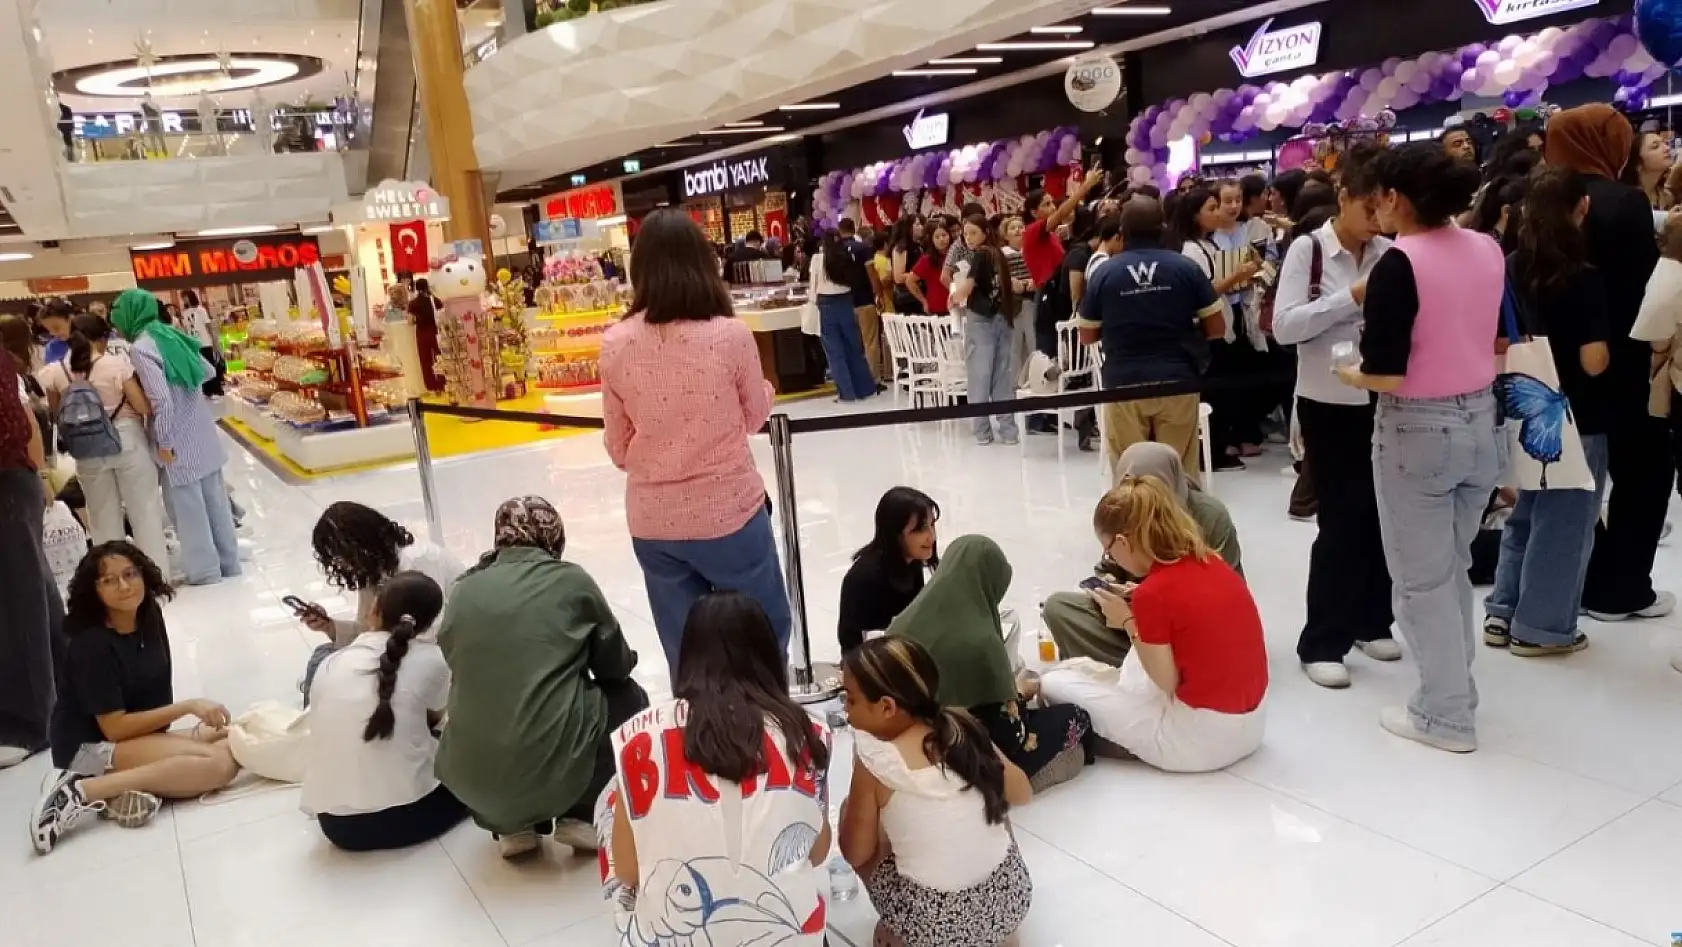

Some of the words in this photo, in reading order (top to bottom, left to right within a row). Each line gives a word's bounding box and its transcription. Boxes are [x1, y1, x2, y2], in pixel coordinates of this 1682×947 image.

[683, 160, 729, 197] bambi
[729, 156, 769, 188] YATAK
[366, 202, 440, 219] SWEETIE
[135, 251, 192, 280] MM
[201, 241, 319, 275] MIROS
